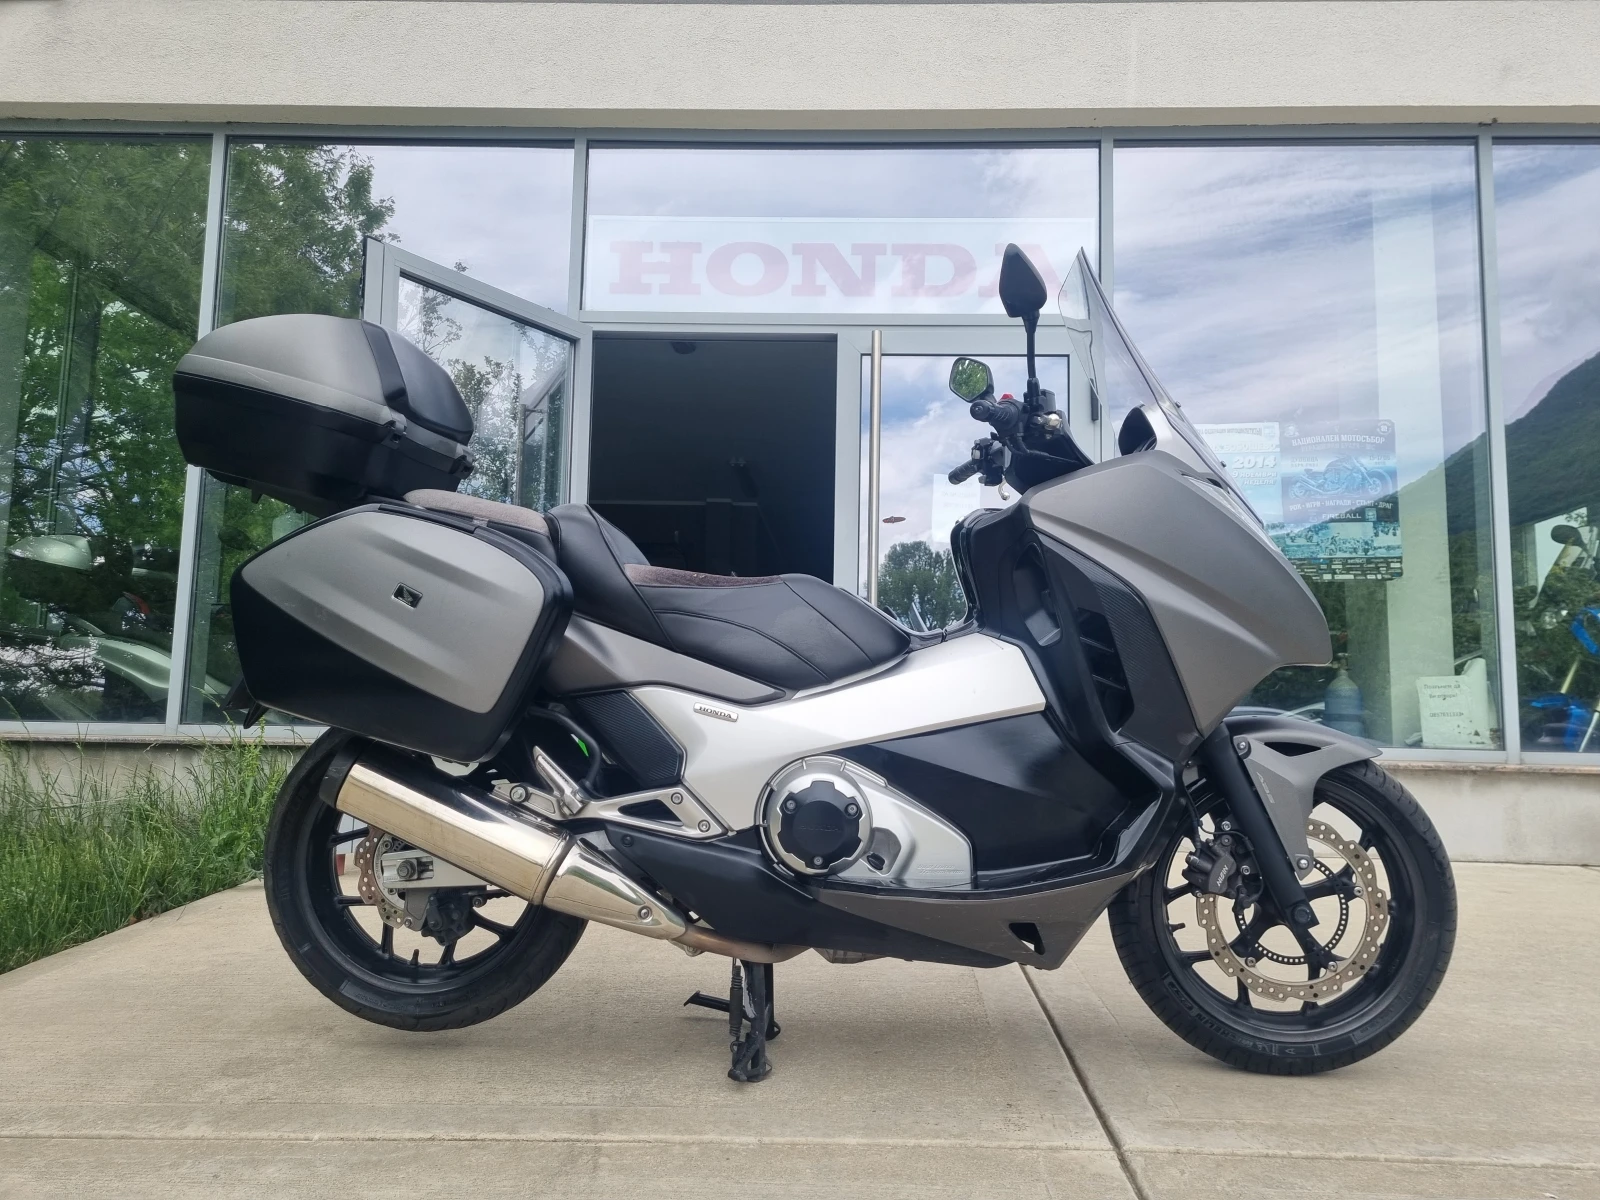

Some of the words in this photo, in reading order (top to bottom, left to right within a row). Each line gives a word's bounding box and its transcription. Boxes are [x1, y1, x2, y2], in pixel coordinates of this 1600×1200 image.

[1292, 434, 1339, 446] НАЦИОНАЛЕН
[1341, 434, 1385, 444] МОТОСЪБОР
[1232, 455, 1277, 469] 2014
[1232, 470, 1239, 478] 9
[699, 706, 732, 719] HONDA
